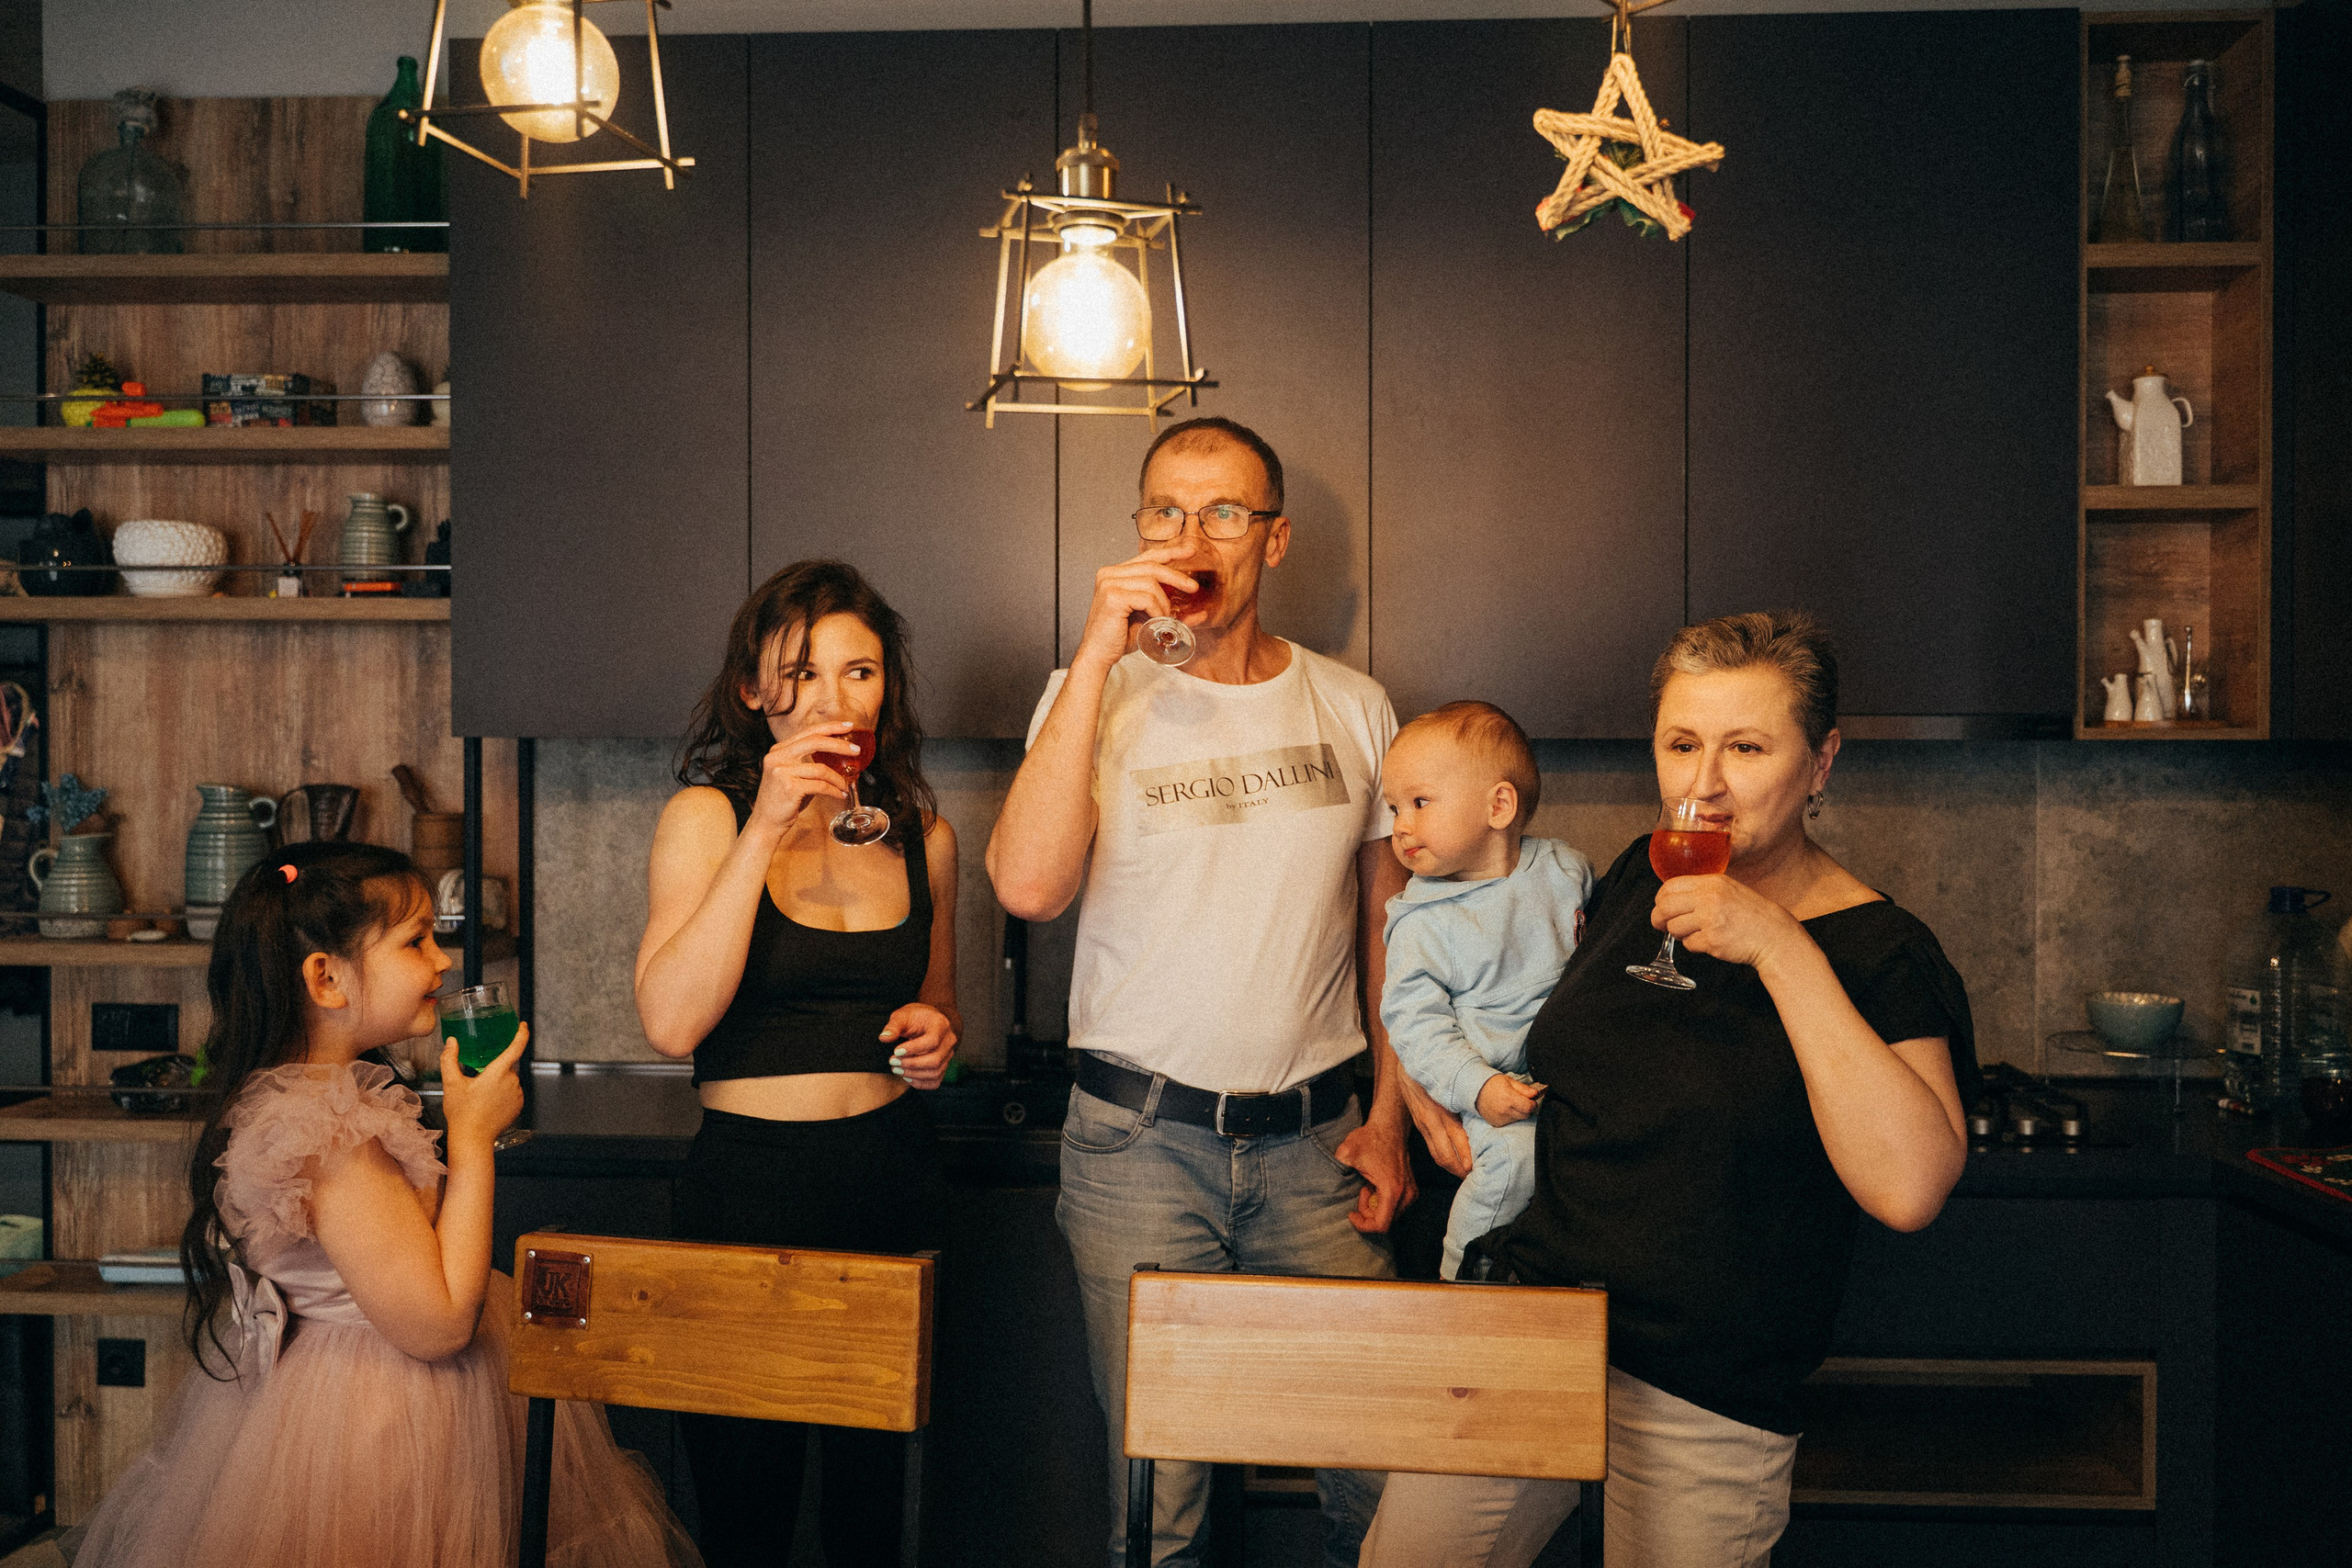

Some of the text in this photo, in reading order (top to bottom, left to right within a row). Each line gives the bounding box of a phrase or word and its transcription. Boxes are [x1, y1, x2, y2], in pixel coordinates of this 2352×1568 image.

[1145, 761, 1335, 807] SERGIO DALLINI
[1225, 797, 1270, 811] by ITALY
